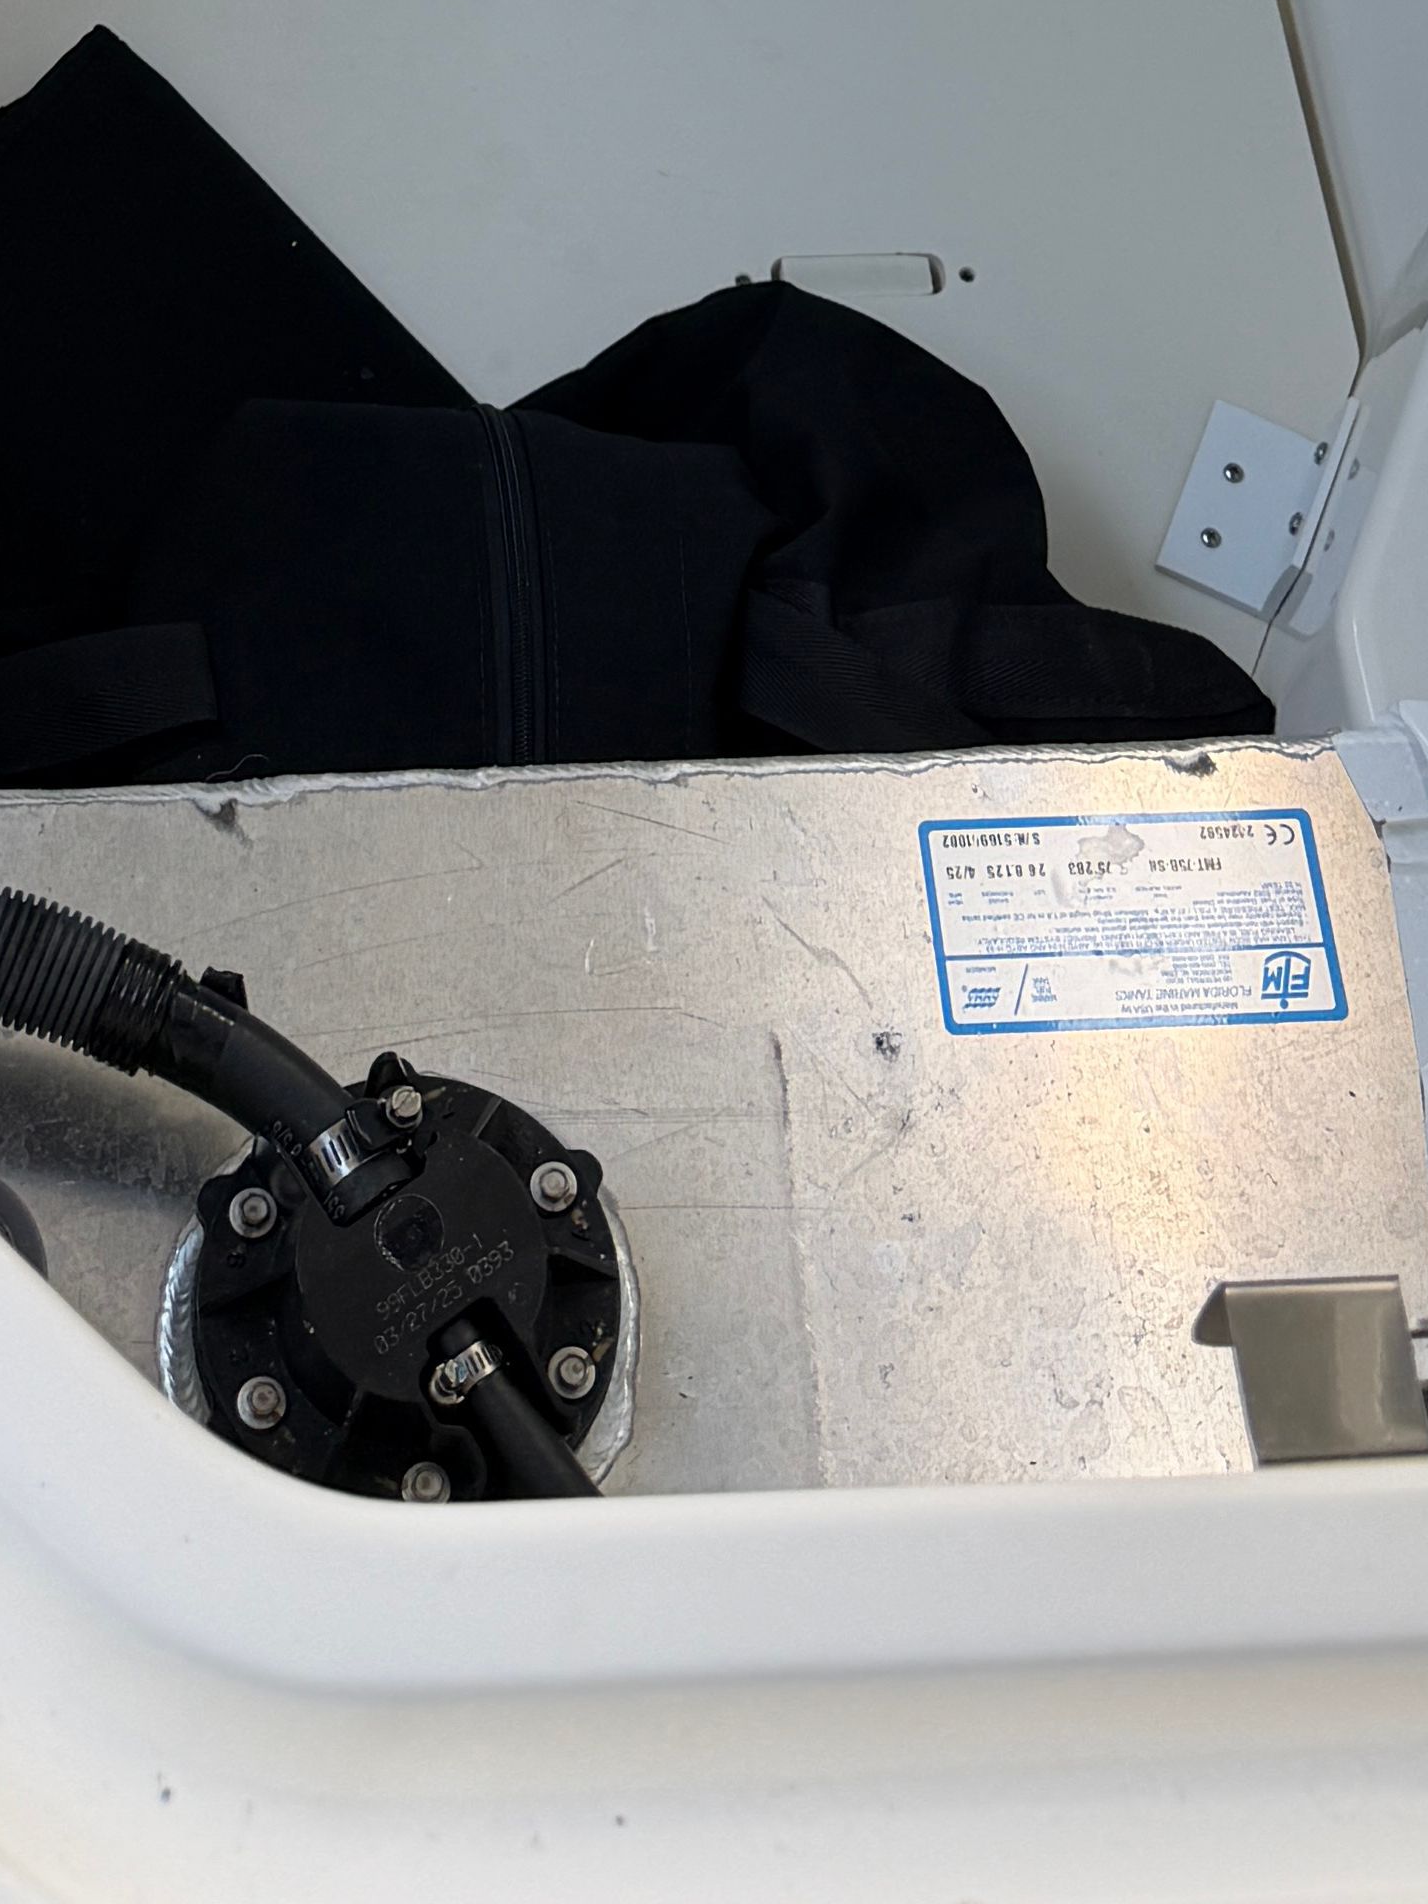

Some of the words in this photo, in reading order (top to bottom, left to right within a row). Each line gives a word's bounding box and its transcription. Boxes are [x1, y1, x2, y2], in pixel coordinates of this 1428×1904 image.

[1264, 824, 1295, 846] CE
[946, 865, 976, 880] 4/25
[1115, 989, 1152, 1002] TANKS
[1156, 988, 1201, 1001] MARINE
[1203, 985, 1252, 999] FLORIDA
[376, 1233, 483, 1320] 99FLB330-1
[374, 1279, 462, 1355] 03/27/25
[467, 1240, 514, 1284] 0393
